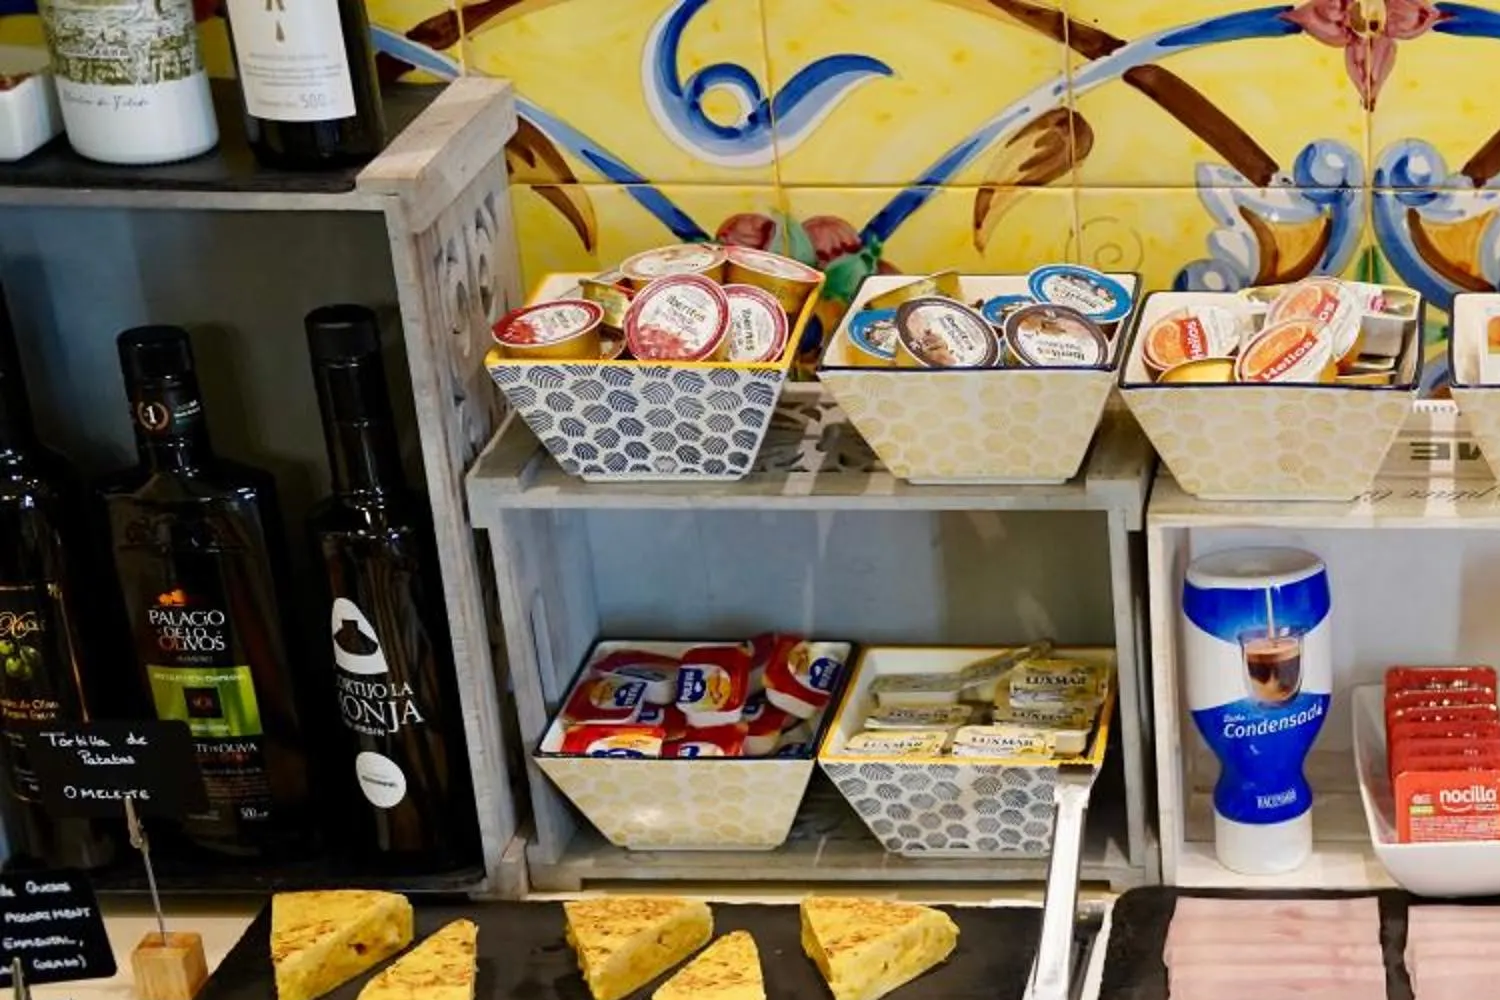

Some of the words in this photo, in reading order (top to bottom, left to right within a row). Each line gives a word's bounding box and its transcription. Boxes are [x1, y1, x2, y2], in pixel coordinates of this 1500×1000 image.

[1261, 338, 1314, 381] Helios
[391, 681, 415, 697] LA
[340, 695, 424, 733] ONJA
[125, 731, 148, 745] de
[1439, 784, 1497, 804] nocilla
